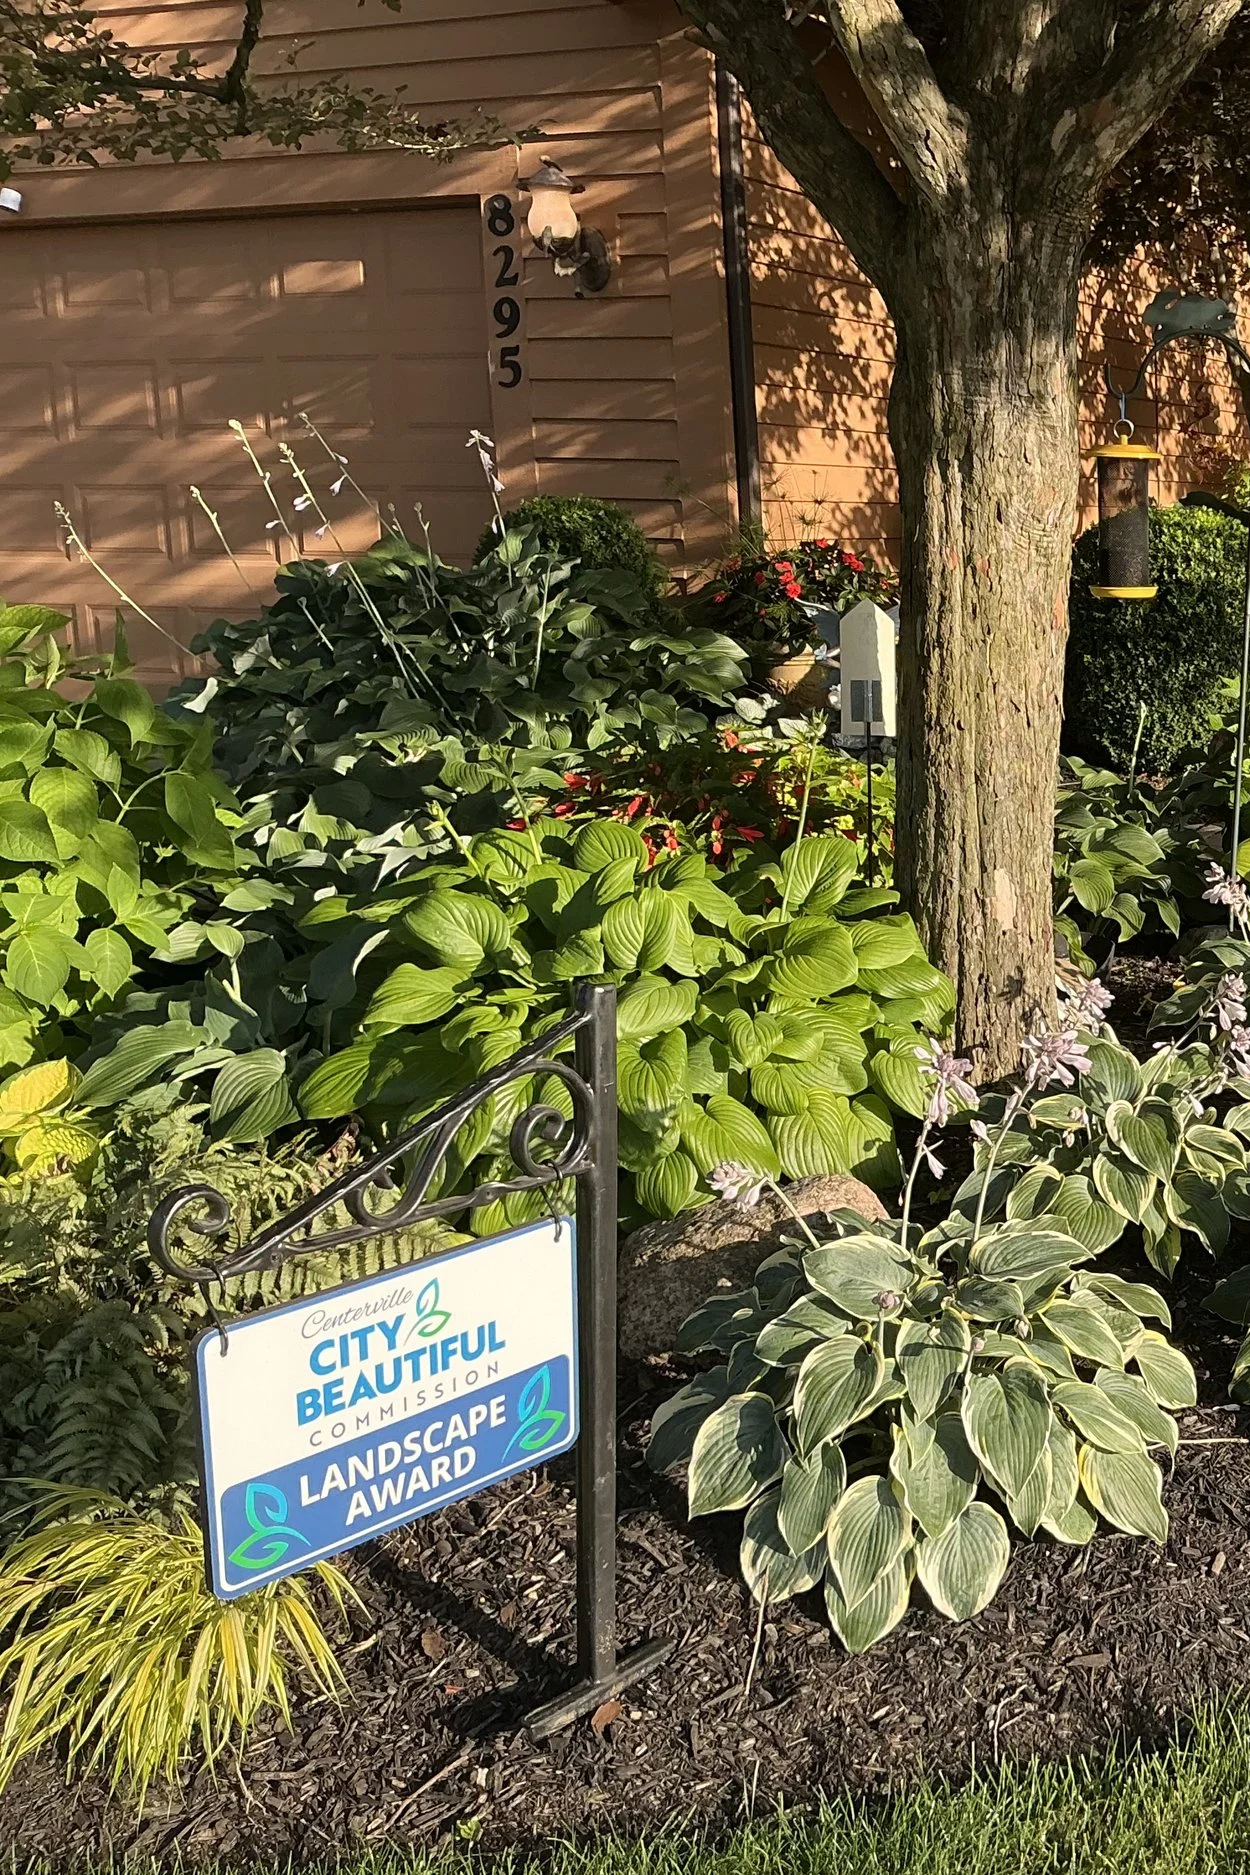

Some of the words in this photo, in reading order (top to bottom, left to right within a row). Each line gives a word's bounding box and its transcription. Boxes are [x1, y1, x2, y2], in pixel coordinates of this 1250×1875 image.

[484, 194, 522, 388] 8295
[301, 1286, 414, 1340] Centerville
[309, 1313, 407, 1376] CITY
[296, 1320, 506, 1427] BEAUTIFUL
[309, 1361, 500, 1447] COMMISSION
[299, 1395, 507, 1508] LANDSCAPE
[345, 1446, 477, 1526] AWARD
